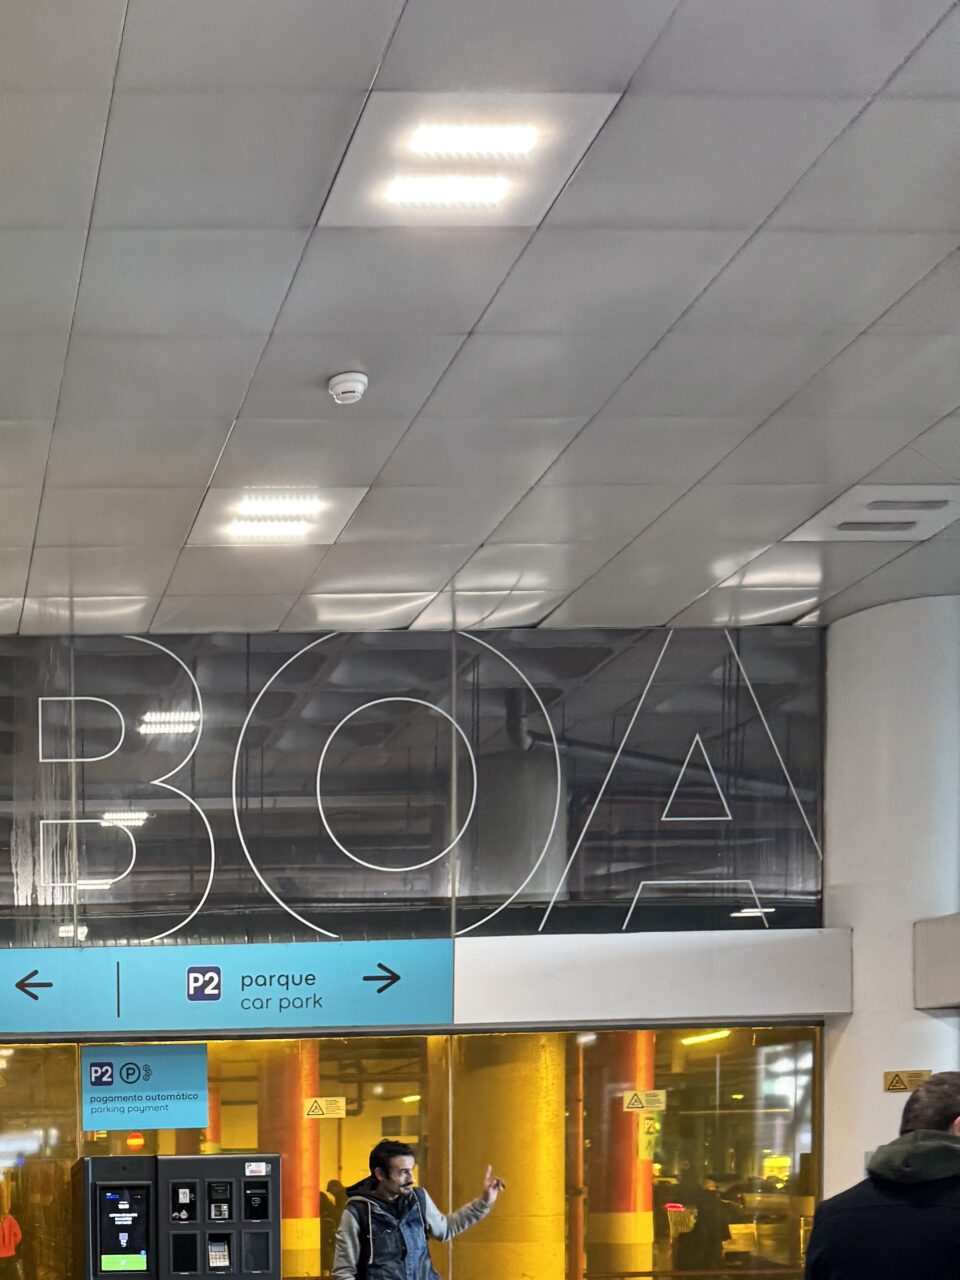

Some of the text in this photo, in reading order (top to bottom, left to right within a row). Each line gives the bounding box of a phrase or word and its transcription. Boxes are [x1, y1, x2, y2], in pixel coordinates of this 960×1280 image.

[189, 971, 220, 995] P2
[241, 973, 317, 991] parque
[240, 993, 323, 1013] car park
[91, 1066, 113, 1082] P2
[90, 1092, 199, 1105] pagamento automático
[91, 1104, 169, 1114] parking payment
